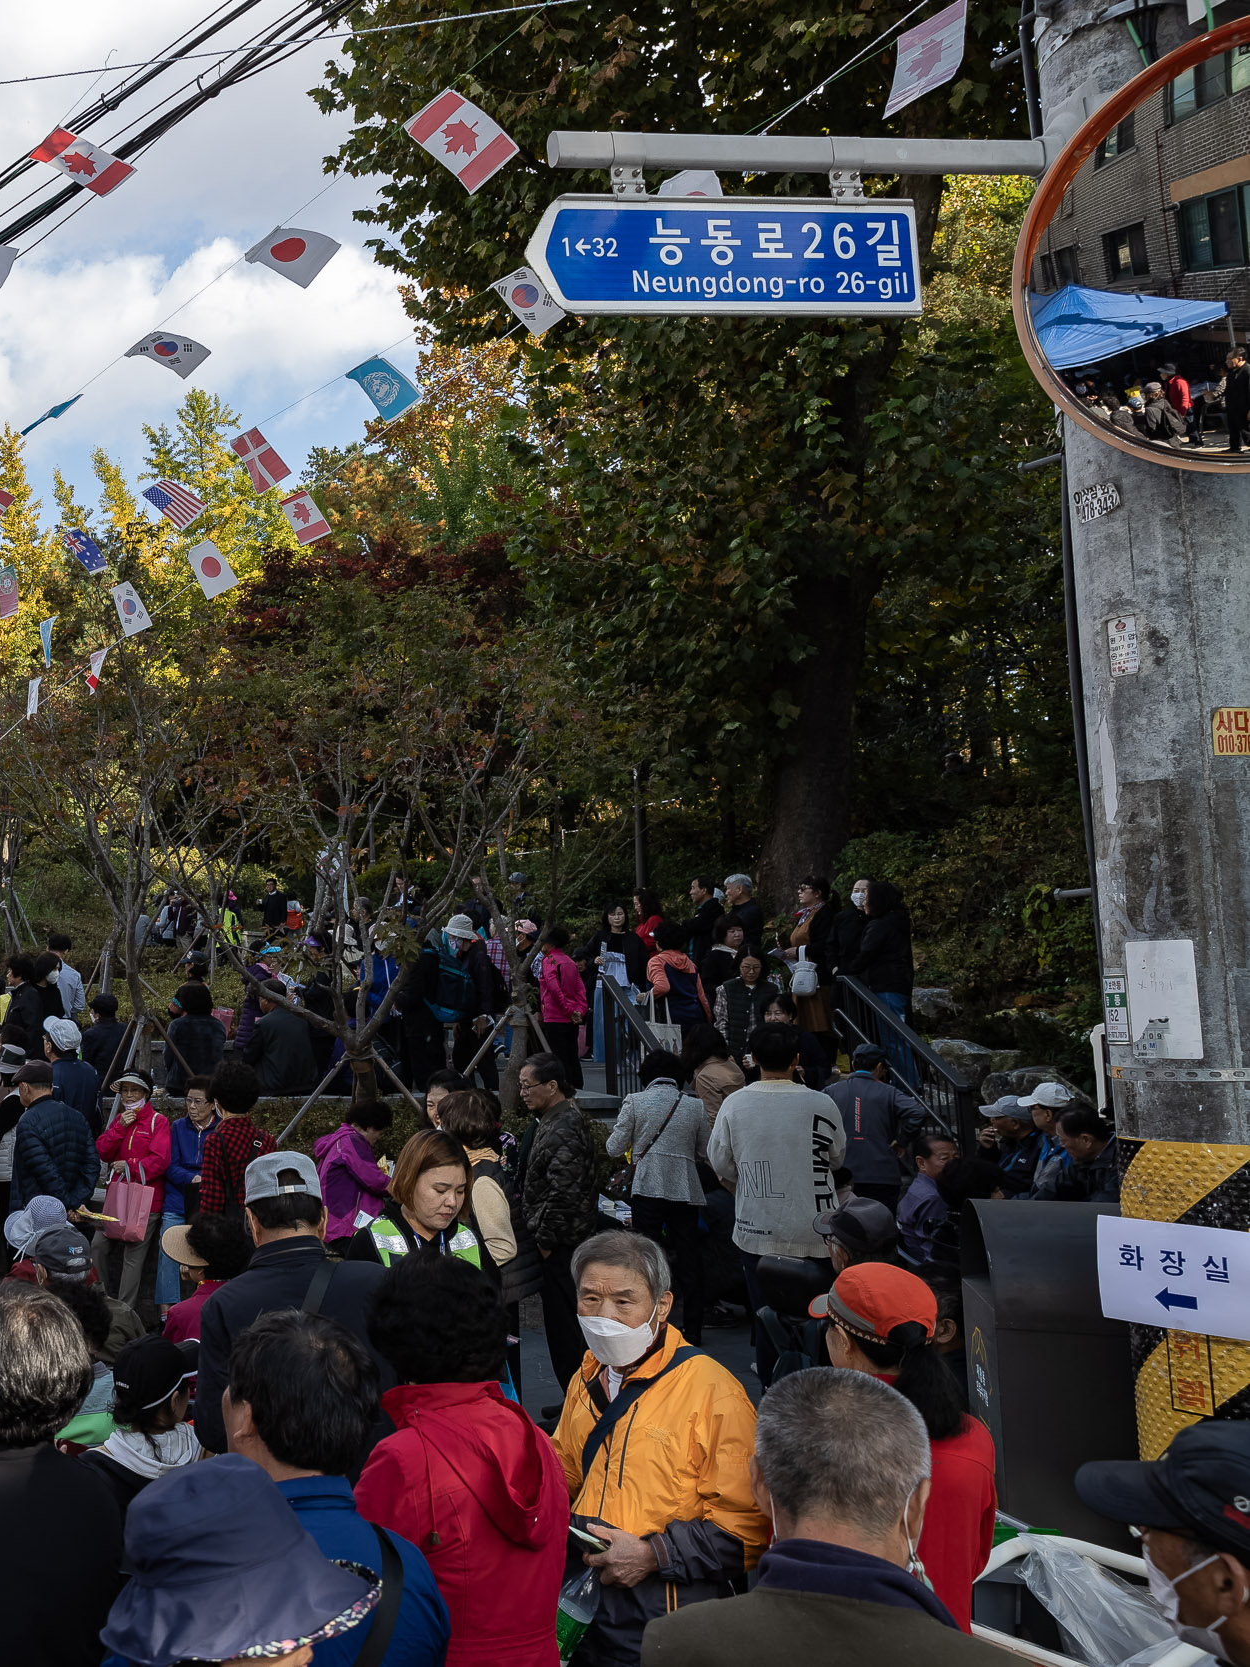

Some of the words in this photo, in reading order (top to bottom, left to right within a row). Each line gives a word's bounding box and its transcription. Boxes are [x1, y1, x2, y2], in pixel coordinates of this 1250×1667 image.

[632, 269, 825, 298] Neungdong-ro
[836, 271, 908, 299] 26-gil
[1118, 1243, 1231, 1284] 화장실
